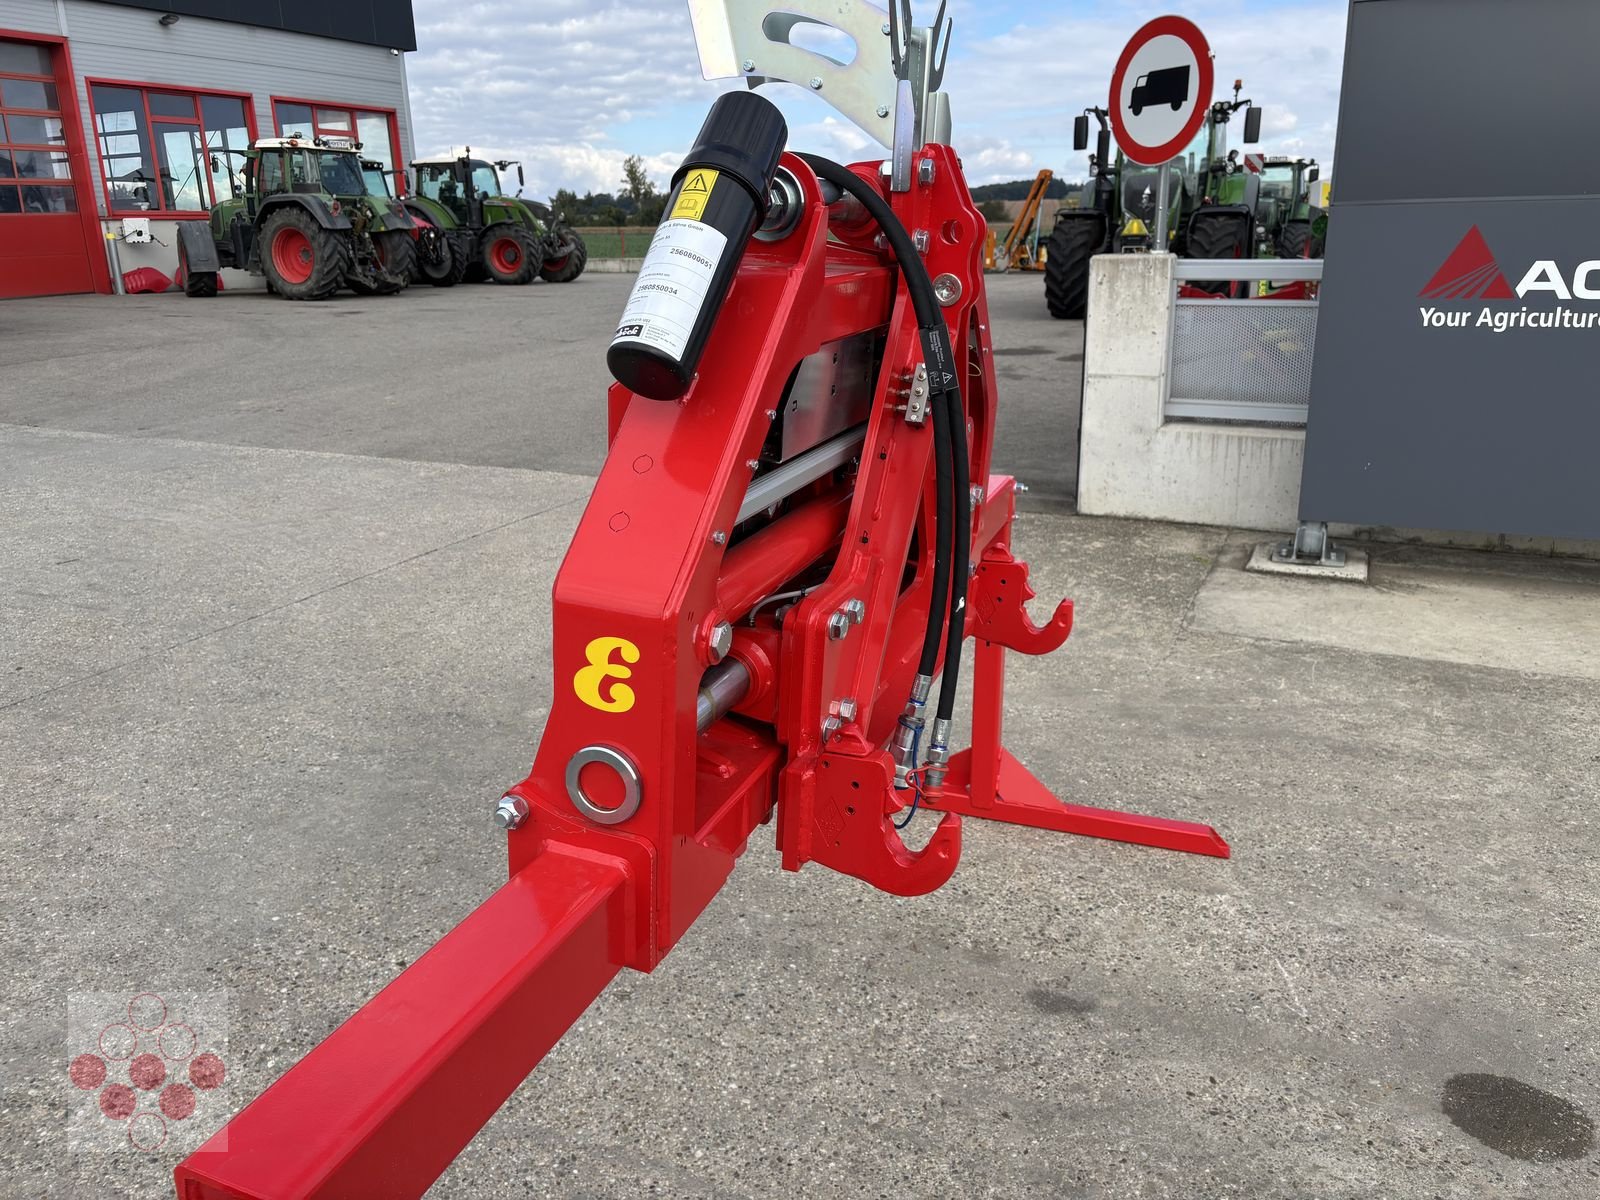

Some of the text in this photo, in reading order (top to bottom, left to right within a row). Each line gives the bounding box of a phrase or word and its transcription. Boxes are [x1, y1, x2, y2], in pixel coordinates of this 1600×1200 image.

[669, 247, 713, 270] 2560800051
[1419, 307, 1600, 333] Your Agricultur
